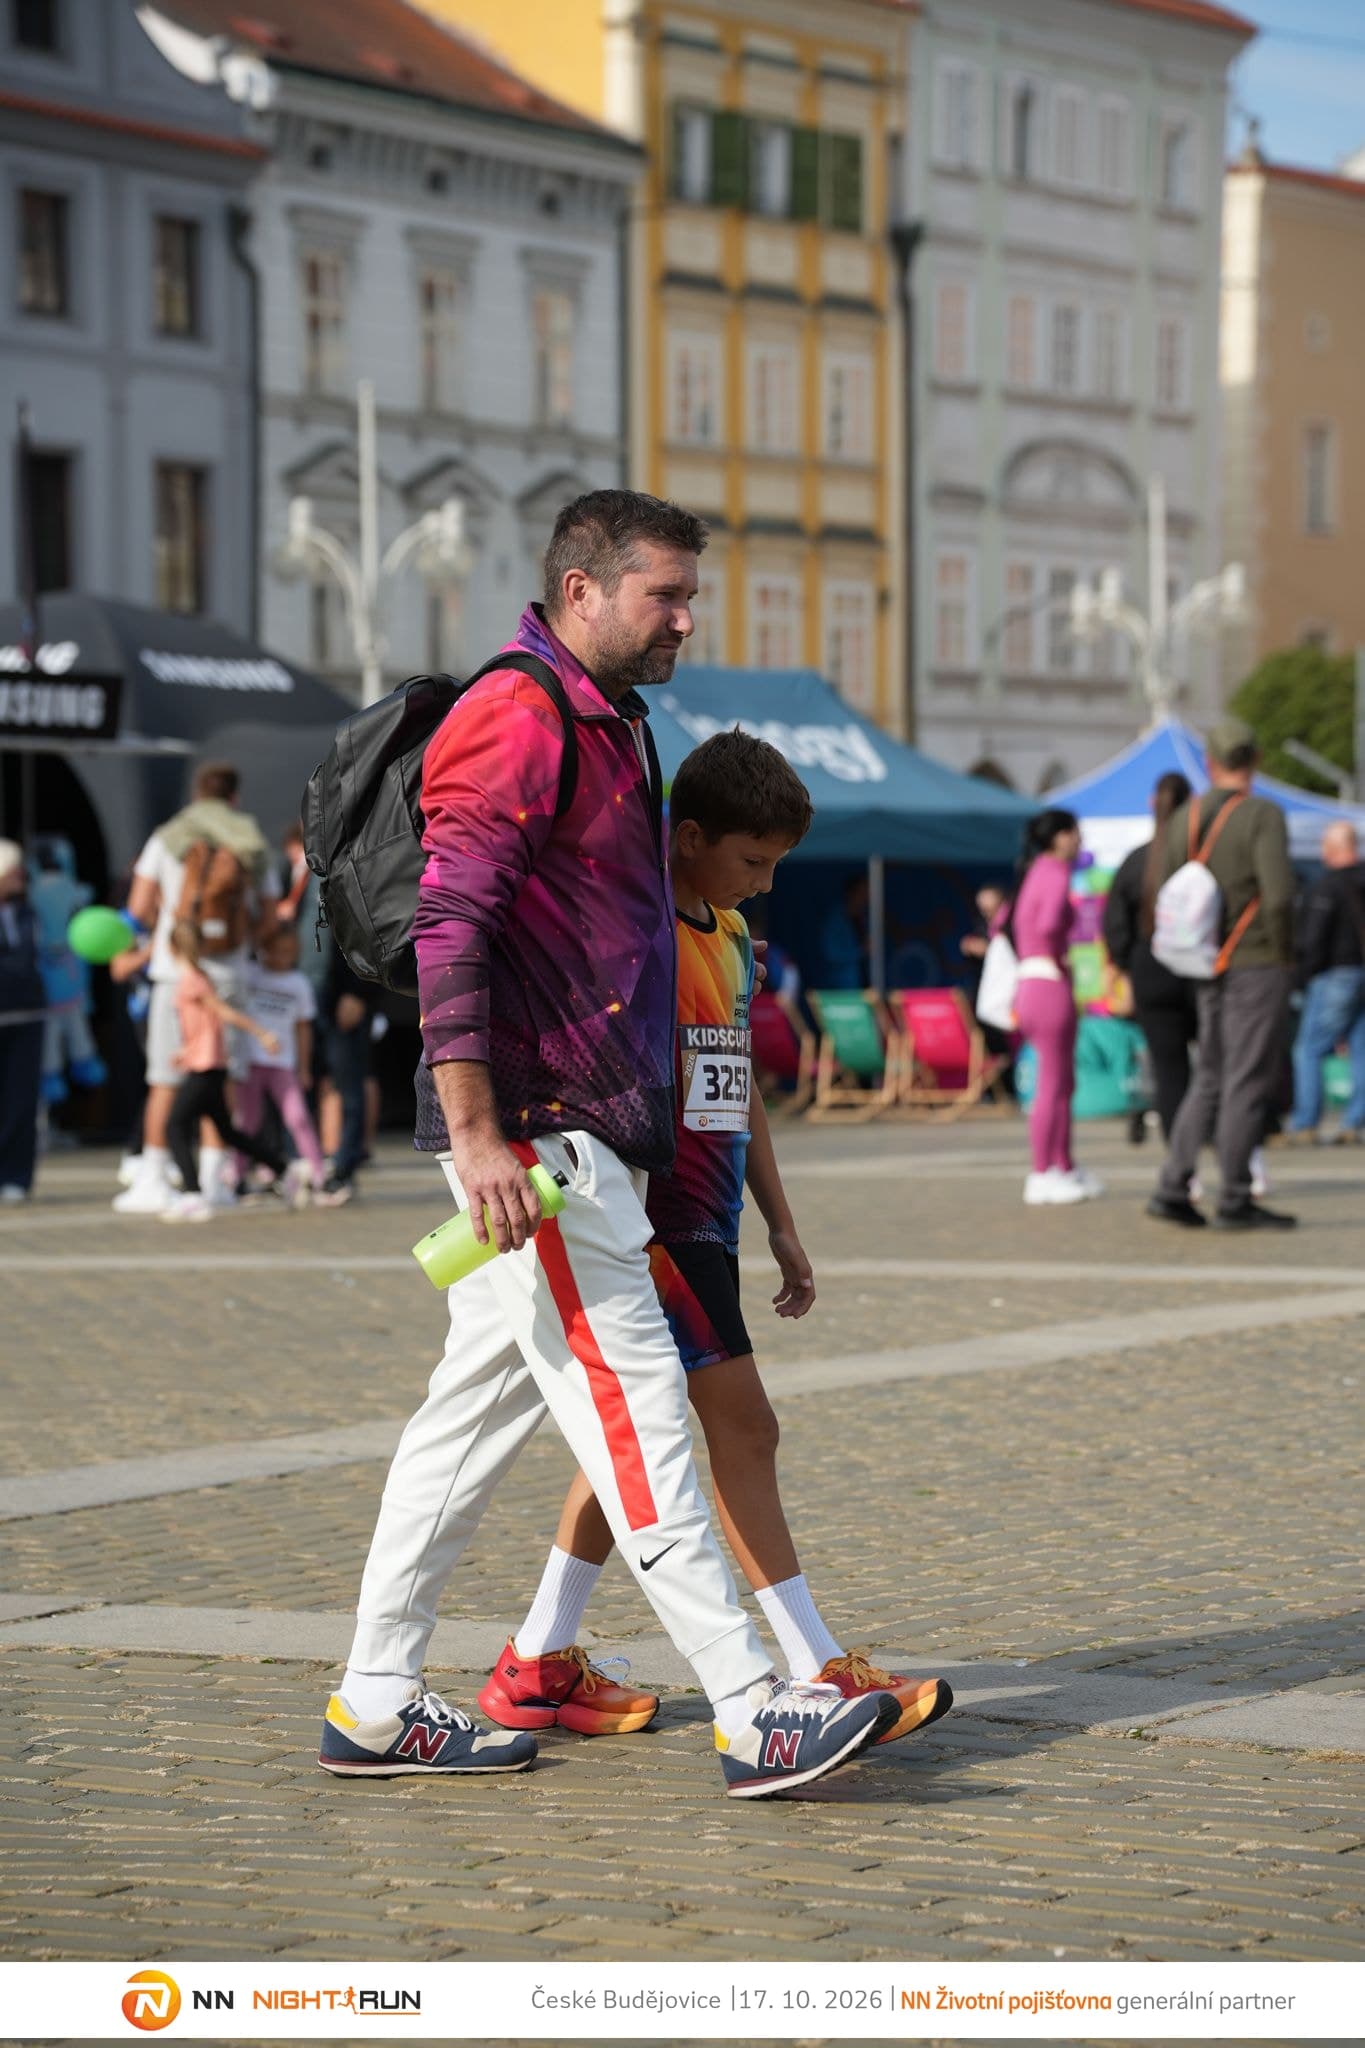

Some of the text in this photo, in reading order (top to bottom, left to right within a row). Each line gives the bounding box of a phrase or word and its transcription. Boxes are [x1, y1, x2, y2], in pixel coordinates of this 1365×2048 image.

[0, 681, 106, 729] SUNG
[395, 1722, 451, 1763] N
[764, 1728, 803, 1769] N
